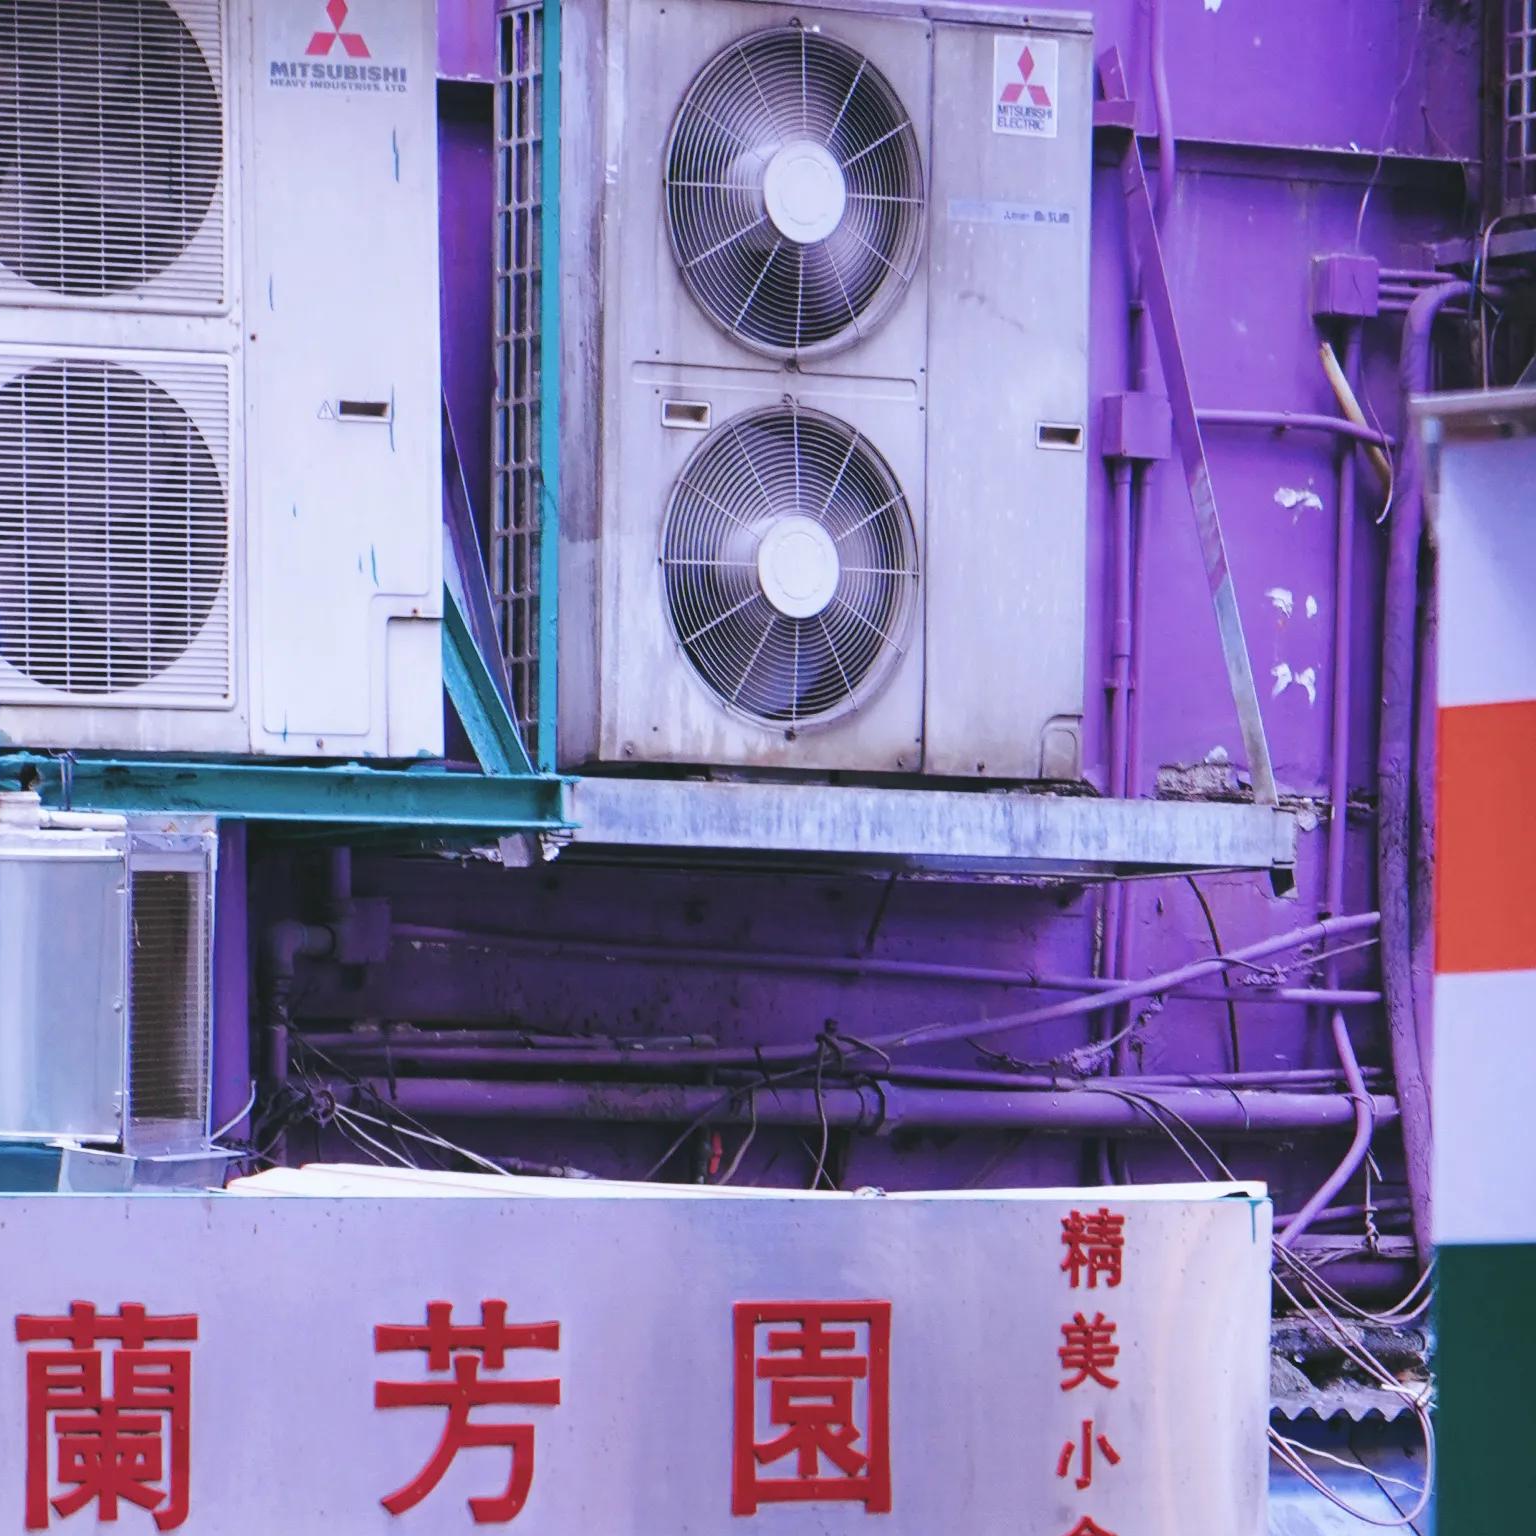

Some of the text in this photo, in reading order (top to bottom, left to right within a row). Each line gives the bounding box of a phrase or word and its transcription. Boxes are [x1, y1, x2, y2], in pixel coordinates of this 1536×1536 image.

[270, 61, 407, 83] MITSUBISHI
[270, 79, 307, 89] HEAVY
[997, 105, 1053, 119] MITSUBISHI
[997, 117, 1044, 131] ELECTRIC
[15, 1298, 892, 1532] 蘭芳園
